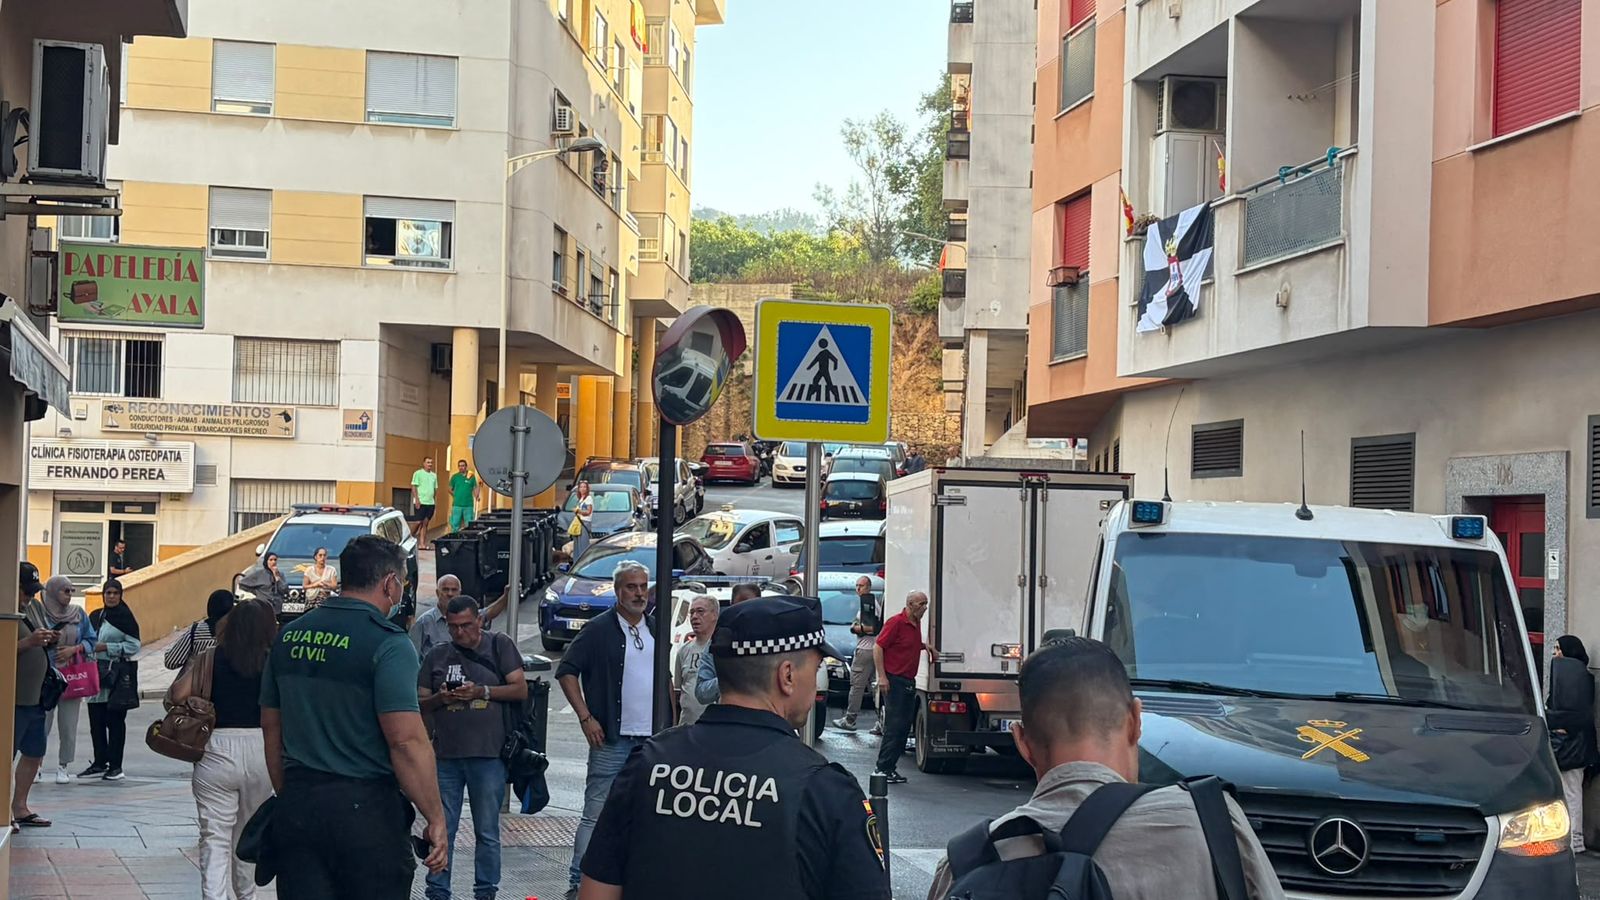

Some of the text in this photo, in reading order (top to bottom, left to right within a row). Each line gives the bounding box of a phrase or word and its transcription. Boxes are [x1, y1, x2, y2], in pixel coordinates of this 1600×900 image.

[64, 252, 199, 282] PAPELERÍA
[126, 292, 199, 316] AYALA
[128, 402, 271, 418] RECONOCIMIENTOS
[128, 414, 270, 427] CONDUCTORES ARMAS ANIMALES PELIGROSOS
[130, 423, 268, 435] SEGURIDAD PRIVADA EMBARCACIONES RECREO
[31, 444, 182, 462] CLÍNICA FISIOTERAPIA OSTEOPATIA
[47, 465, 165, 480] FERNANDO PEREA
[282, 630, 350, 649] GUARDIA
[291, 646, 326, 662] CIVIL
[448, 664, 462, 674] THE
[649, 763, 779, 803] POLICIA
[655, 788, 762, 828] LOCAL
